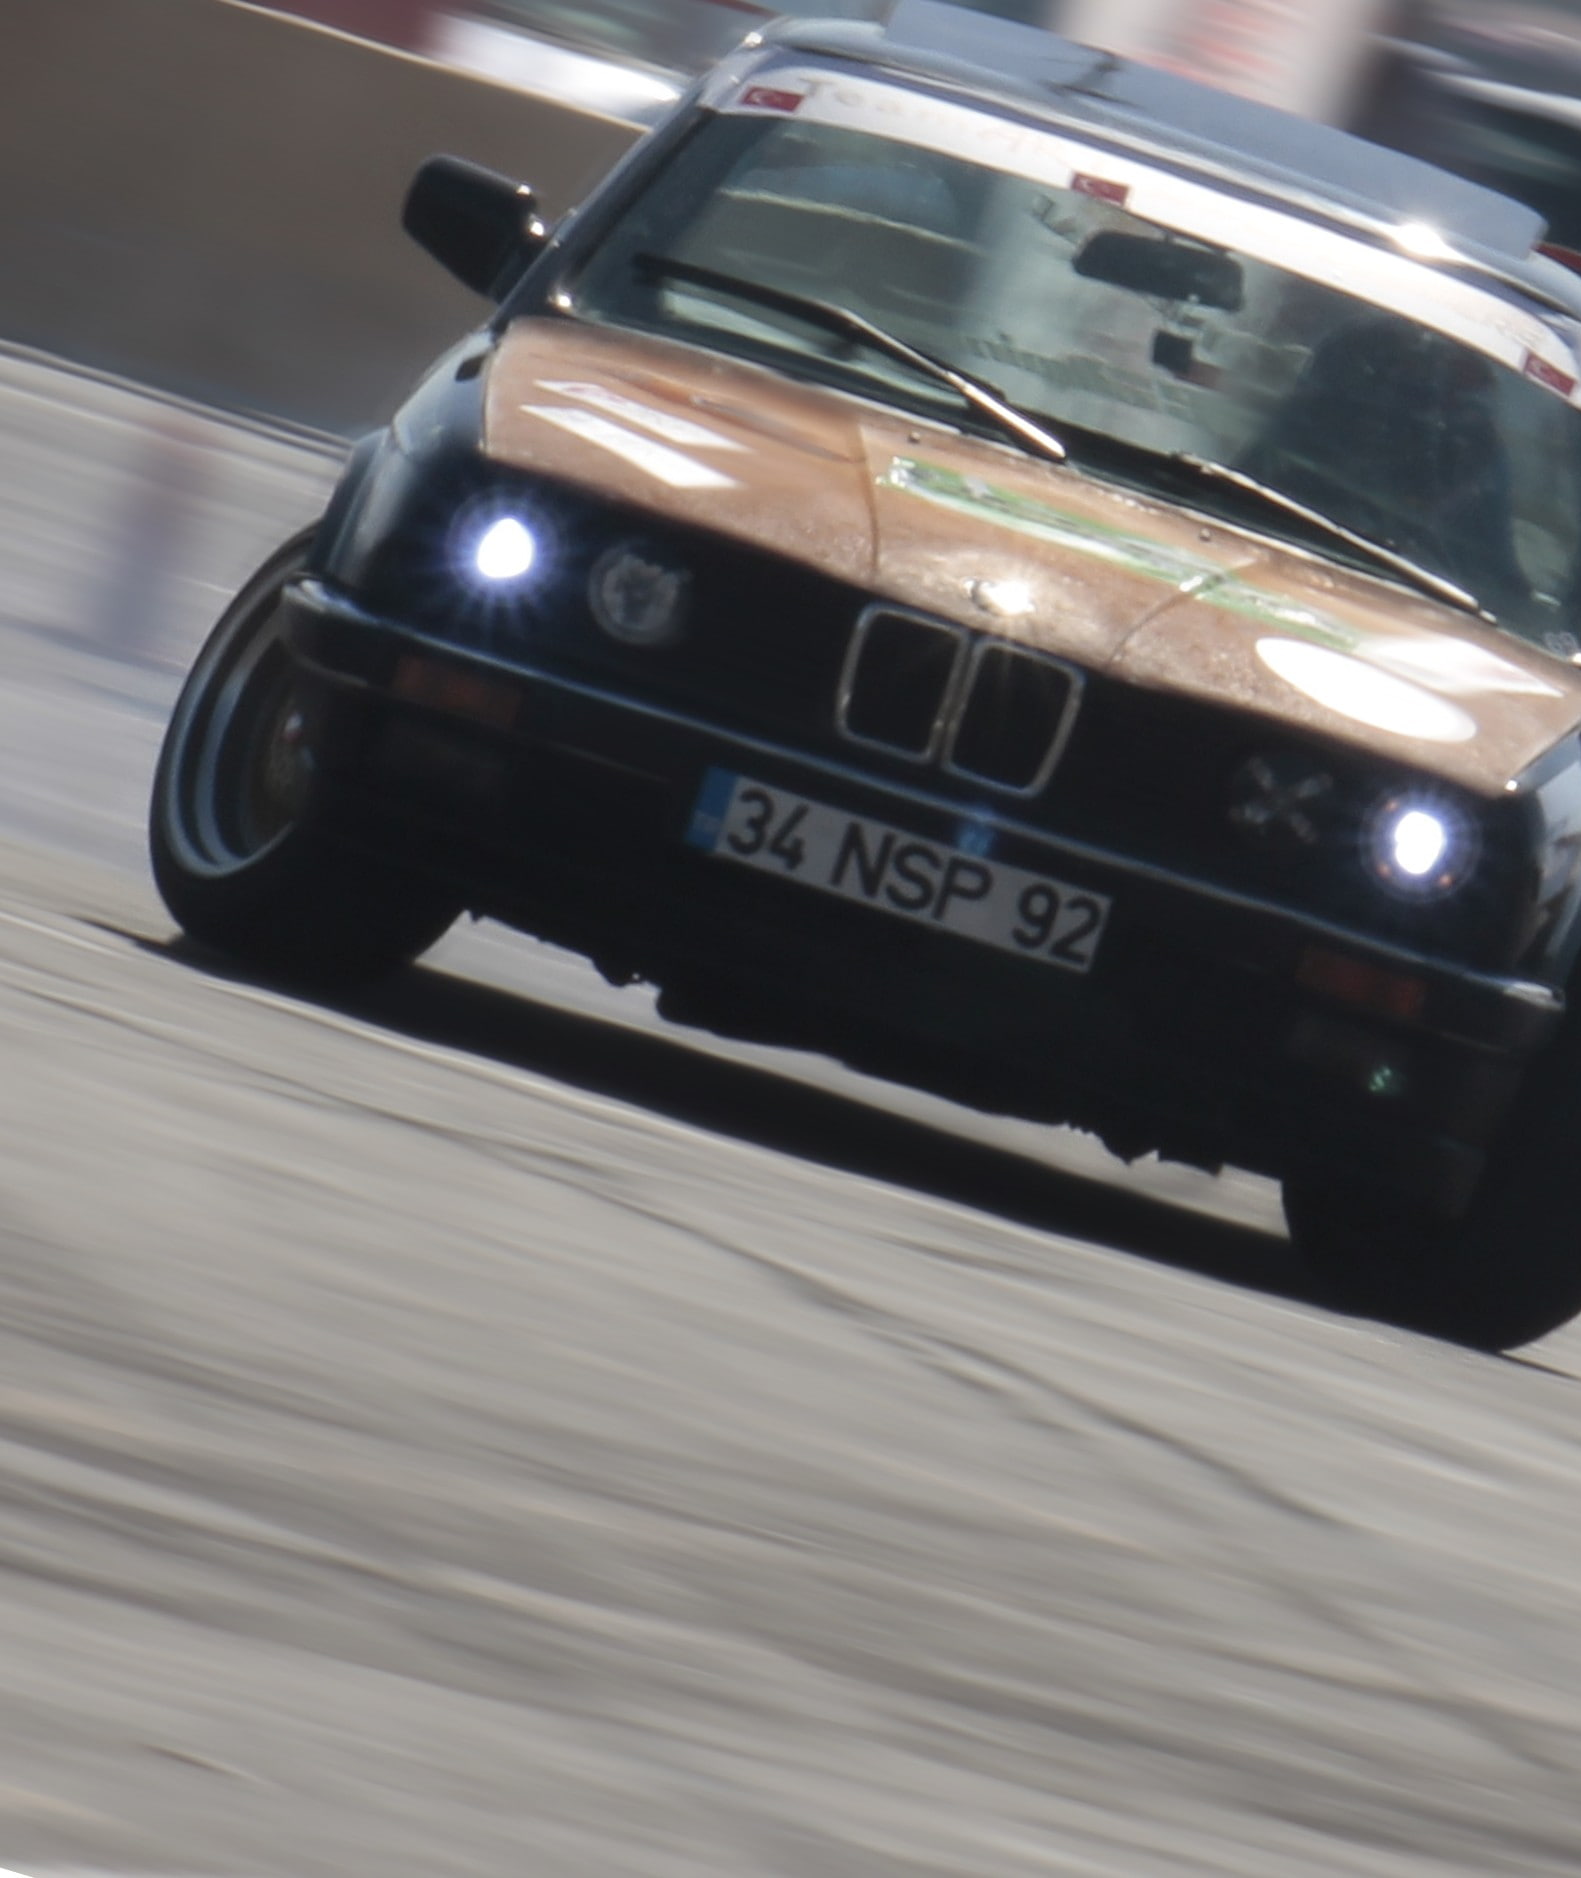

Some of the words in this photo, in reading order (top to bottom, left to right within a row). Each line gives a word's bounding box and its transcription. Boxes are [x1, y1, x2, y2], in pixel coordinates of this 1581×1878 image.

[727, 788, 809, 870] 34
[831, 822, 993, 920] NSP
[1011, 883, 1099, 963] 92
